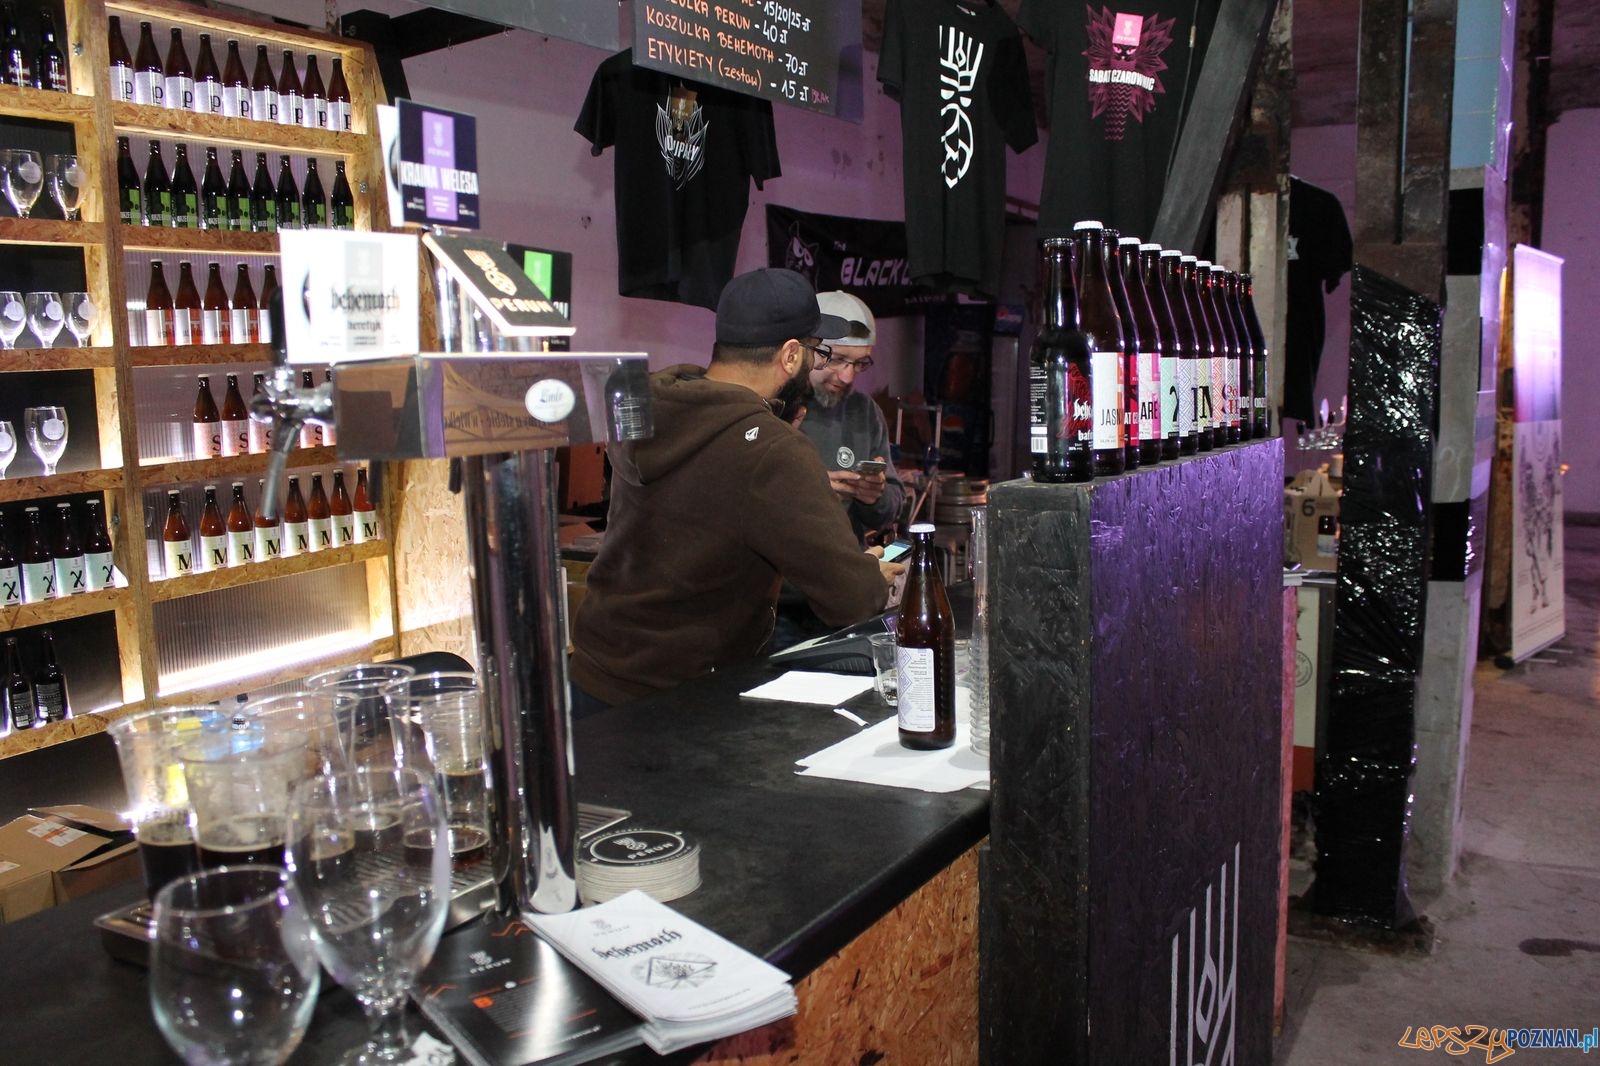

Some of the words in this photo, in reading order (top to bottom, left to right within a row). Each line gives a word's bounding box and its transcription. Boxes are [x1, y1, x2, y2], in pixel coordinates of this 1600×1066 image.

[714, 5, 751, 30] PERUN
[762, 20, 778, 43] 40
[646, 5, 710, 42] KOSZULKA
[717, 31, 774, 63] BEHEMOTH
[785, 53, 798, 74] 70
[648, 37, 713, 73] ETYKIETY
[718, 57, 762, 91] (zestaw)
[781, 79, 796, 98] 15
[1089, 68, 1112, 83] SABAT
[1111, 69, 1155, 91] CZAROWNIC
[440, 167, 480, 196] WELESA
[841, 257, 904, 287] BLACK
[488, 297, 554, 313] PERUN
[1302, 499, 1315, 517] 6
[341, 526, 354, 541] M
[363, 521, 377, 537] M
[266, 538, 280, 555] M
[177, 553, 192, 570] M
[213, 547, 228, 565] M
[627, 843, 674, 860] PERUN
[591, 928, 683, 962] behemoth
[470, 957, 511, 974] PERUN
